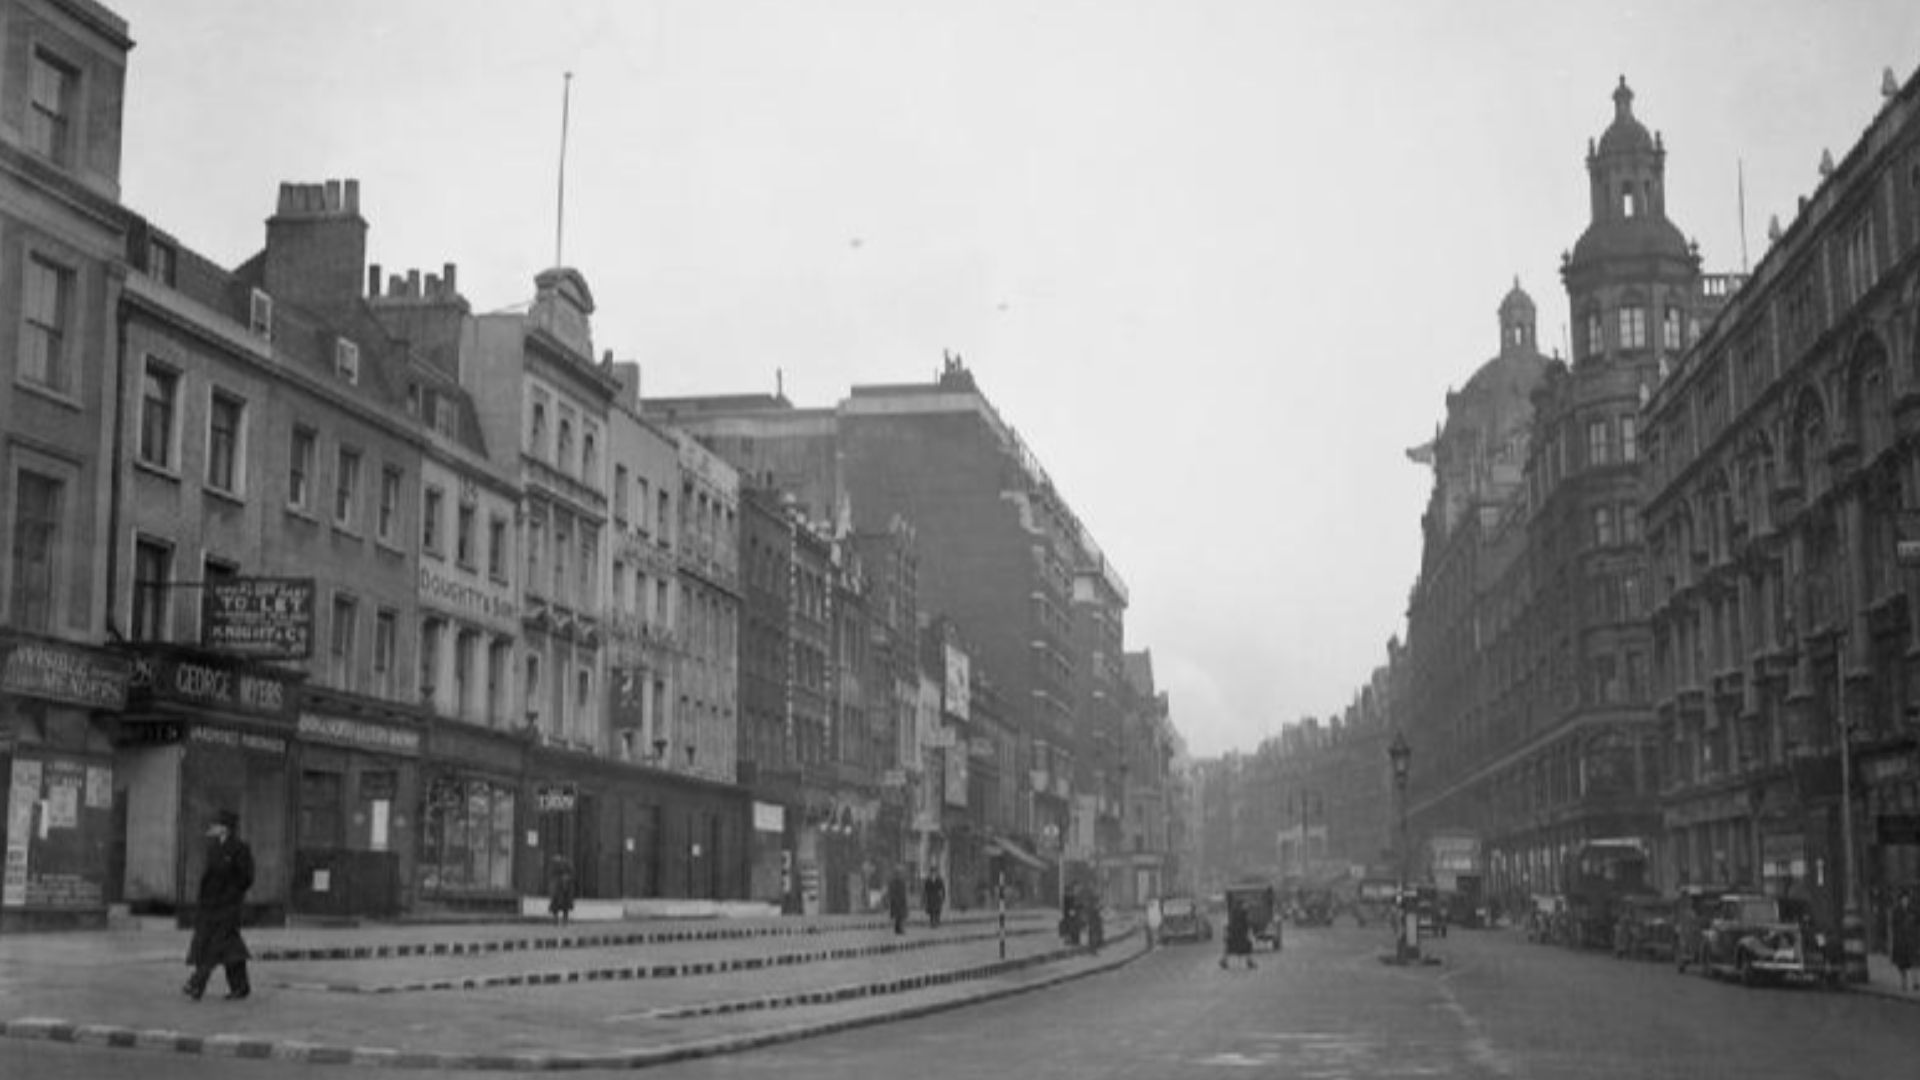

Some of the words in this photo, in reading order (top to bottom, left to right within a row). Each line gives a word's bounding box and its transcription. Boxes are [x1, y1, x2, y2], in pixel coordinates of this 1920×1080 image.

[221, 596, 246, 610] TO
[261, 596, 304, 612] LET
[420, 567, 483, 608] DOUGHTY
[175, 662, 232, 703] GEORGE
[240, 674, 284, 710] MYERS
